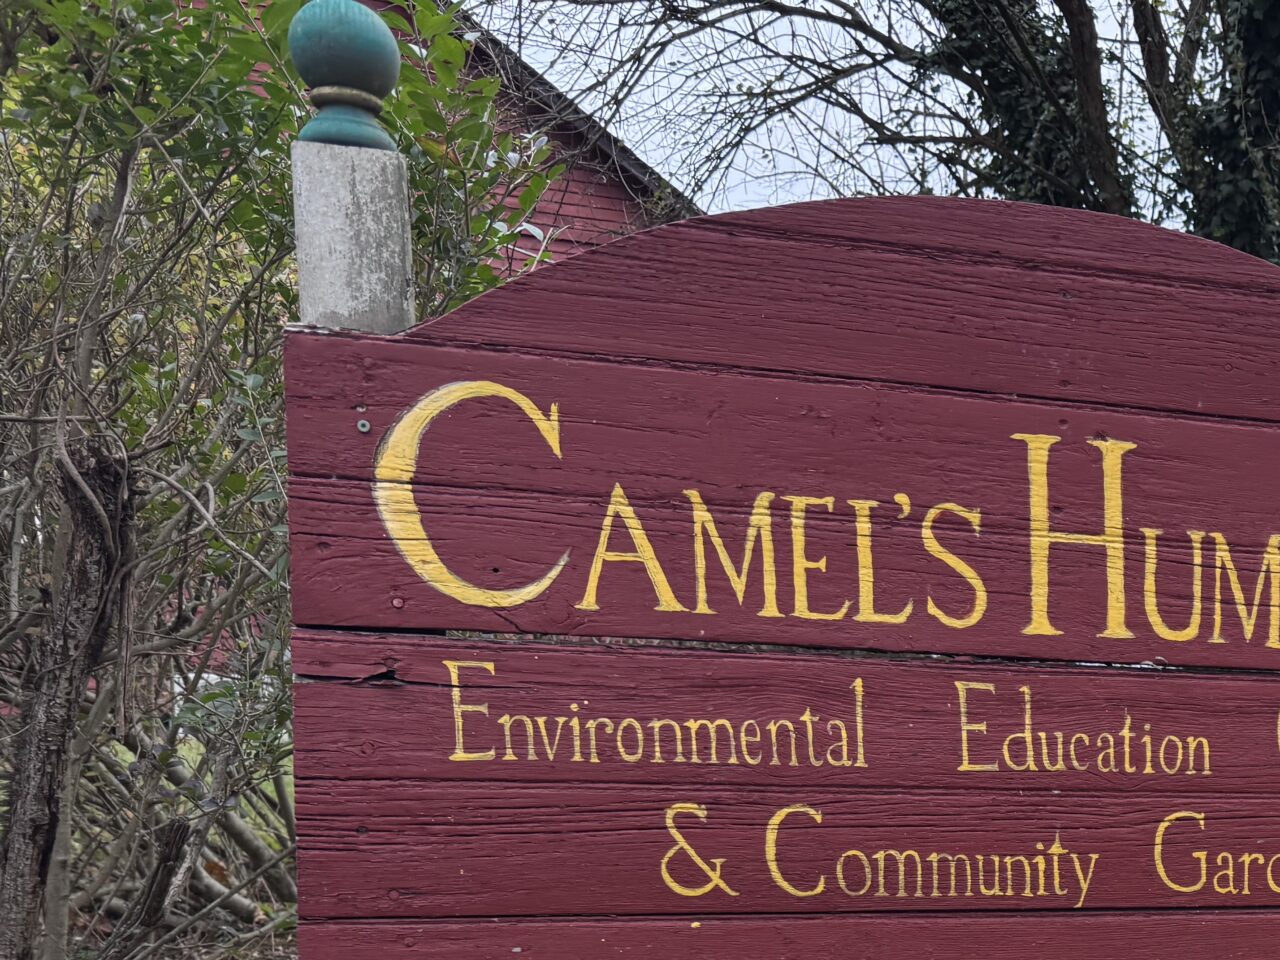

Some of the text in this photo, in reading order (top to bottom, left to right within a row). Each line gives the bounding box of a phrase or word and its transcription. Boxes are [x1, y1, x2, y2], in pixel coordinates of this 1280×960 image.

[373, 380, 989, 630] CAMEL'S
[442, 659, 868, 769] Environmental
[955, 680, 1213, 776] Education
[659, 802, 740, 898] &
[764, 804, 1100, 909] Community
